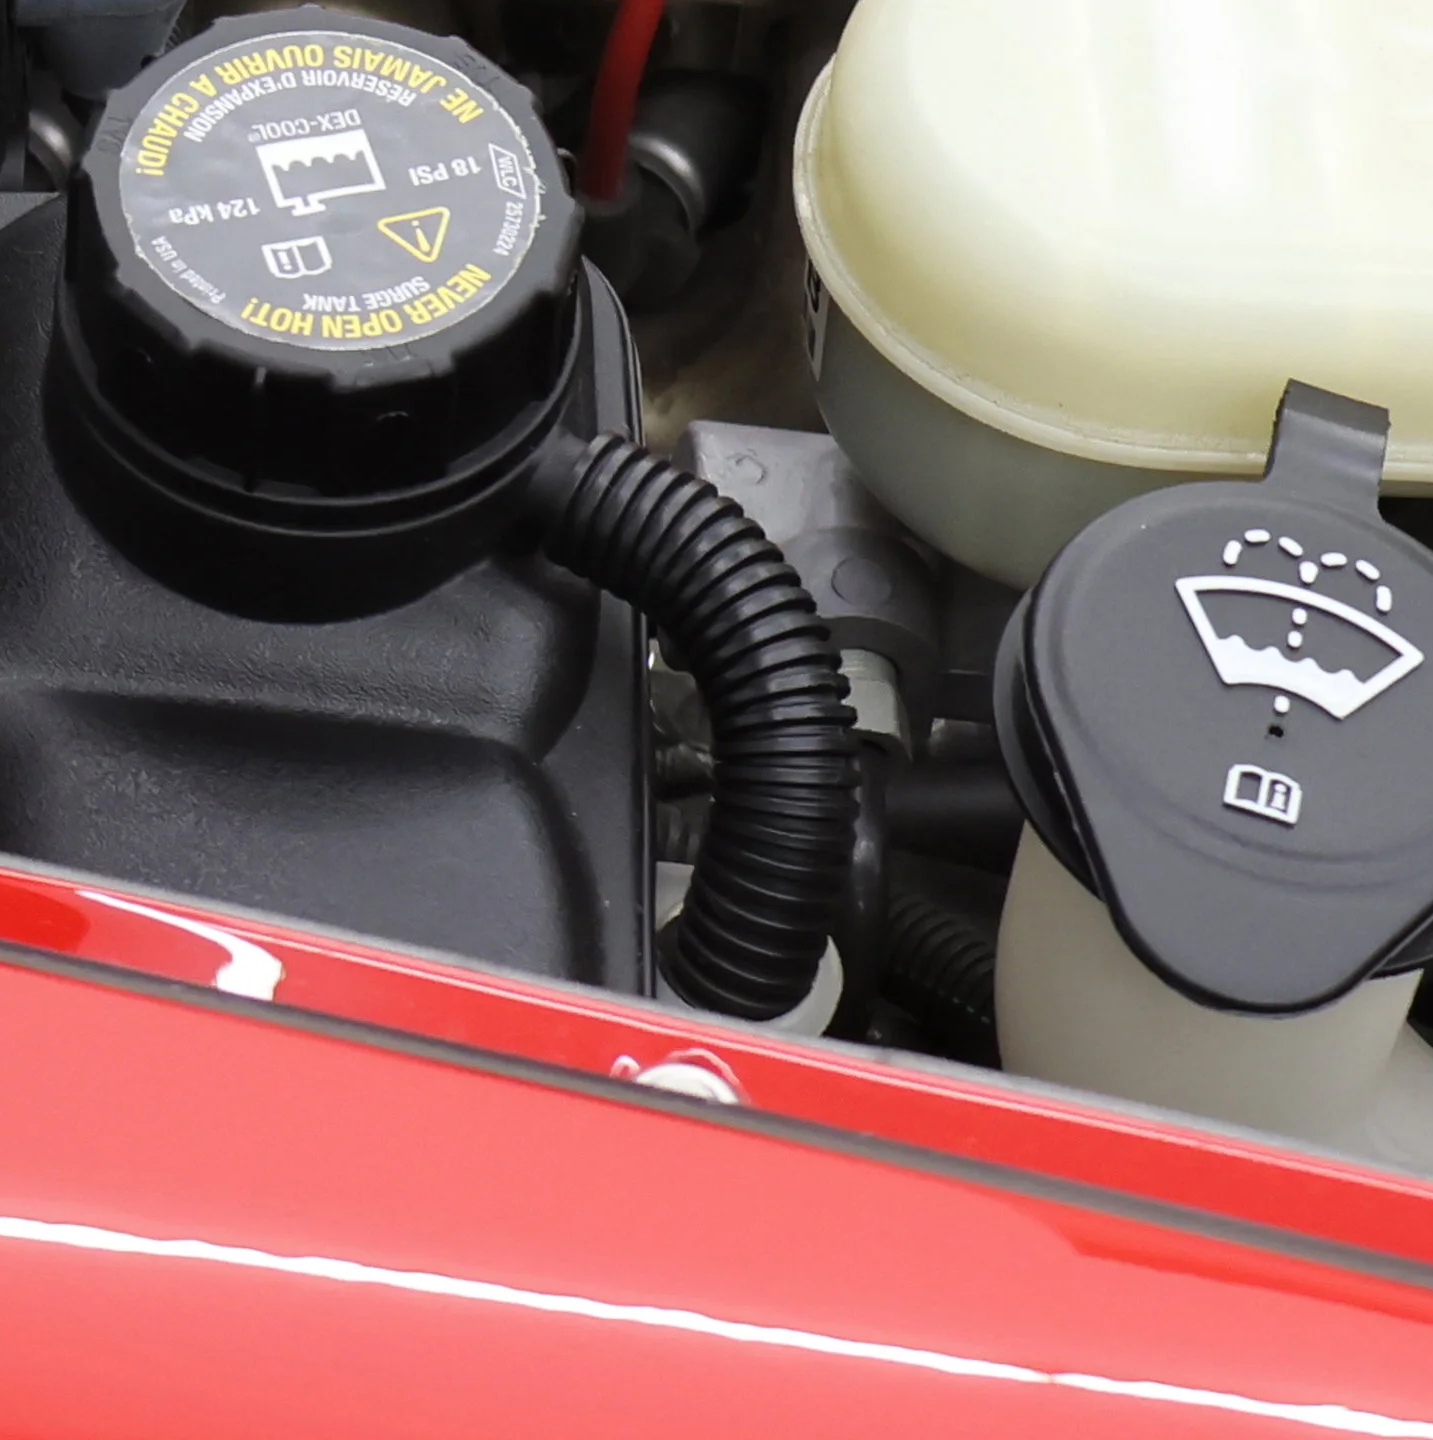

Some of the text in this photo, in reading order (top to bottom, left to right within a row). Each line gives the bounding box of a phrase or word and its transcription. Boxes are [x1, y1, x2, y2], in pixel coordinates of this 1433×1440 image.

[213, 44, 323, 80] OUVRIR
[333, 45, 446, 96] JAMAIS
[189, 74, 217, 98] A
[303, 68, 416, 107] RÉSERVOIR
[183, 71, 294, 143] D'EXPANSION
[443, 88, 484, 123] NE
[134, 93, 198, 176] CHAUD!
[408, 155, 481, 186] 18 PSI
[496, 156, 518, 187] WLC
[167, 197, 259, 226] 124 kPa
[152, 236, 177, 263] USA
[185, 269, 226, 304] Printed
[240, 263, 491, 338] NEVER OPEN HOT!
[303, 275, 430, 312] SURGE TANK
